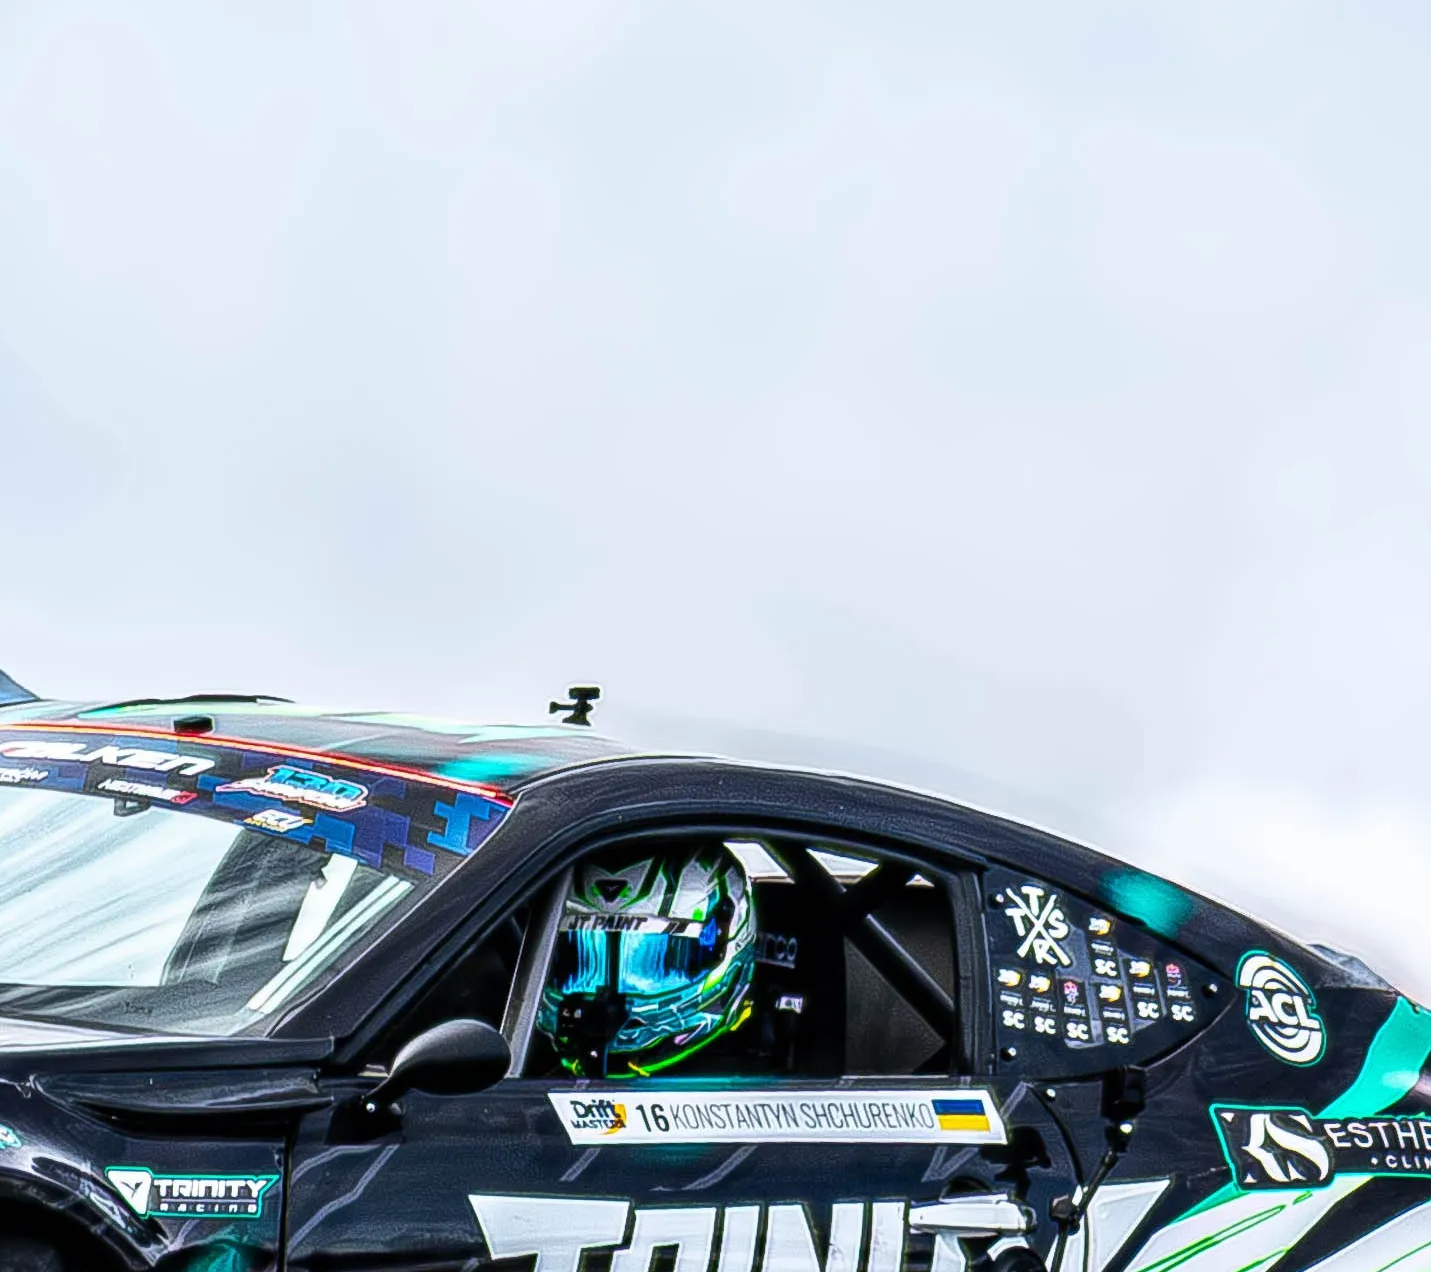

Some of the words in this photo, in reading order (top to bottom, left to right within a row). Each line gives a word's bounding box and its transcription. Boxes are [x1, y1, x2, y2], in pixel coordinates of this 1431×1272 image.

[1249, 989, 1321, 1029] ACL
[569, 1099, 622, 1119] Drift
[635, 1103, 670, 1133] 16
[669, 1103, 797, 1130] KONSTANTYN
[801, 1101, 935, 1130] SHCHURENKO
[153, 1179, 268, 1198] TRINITY
